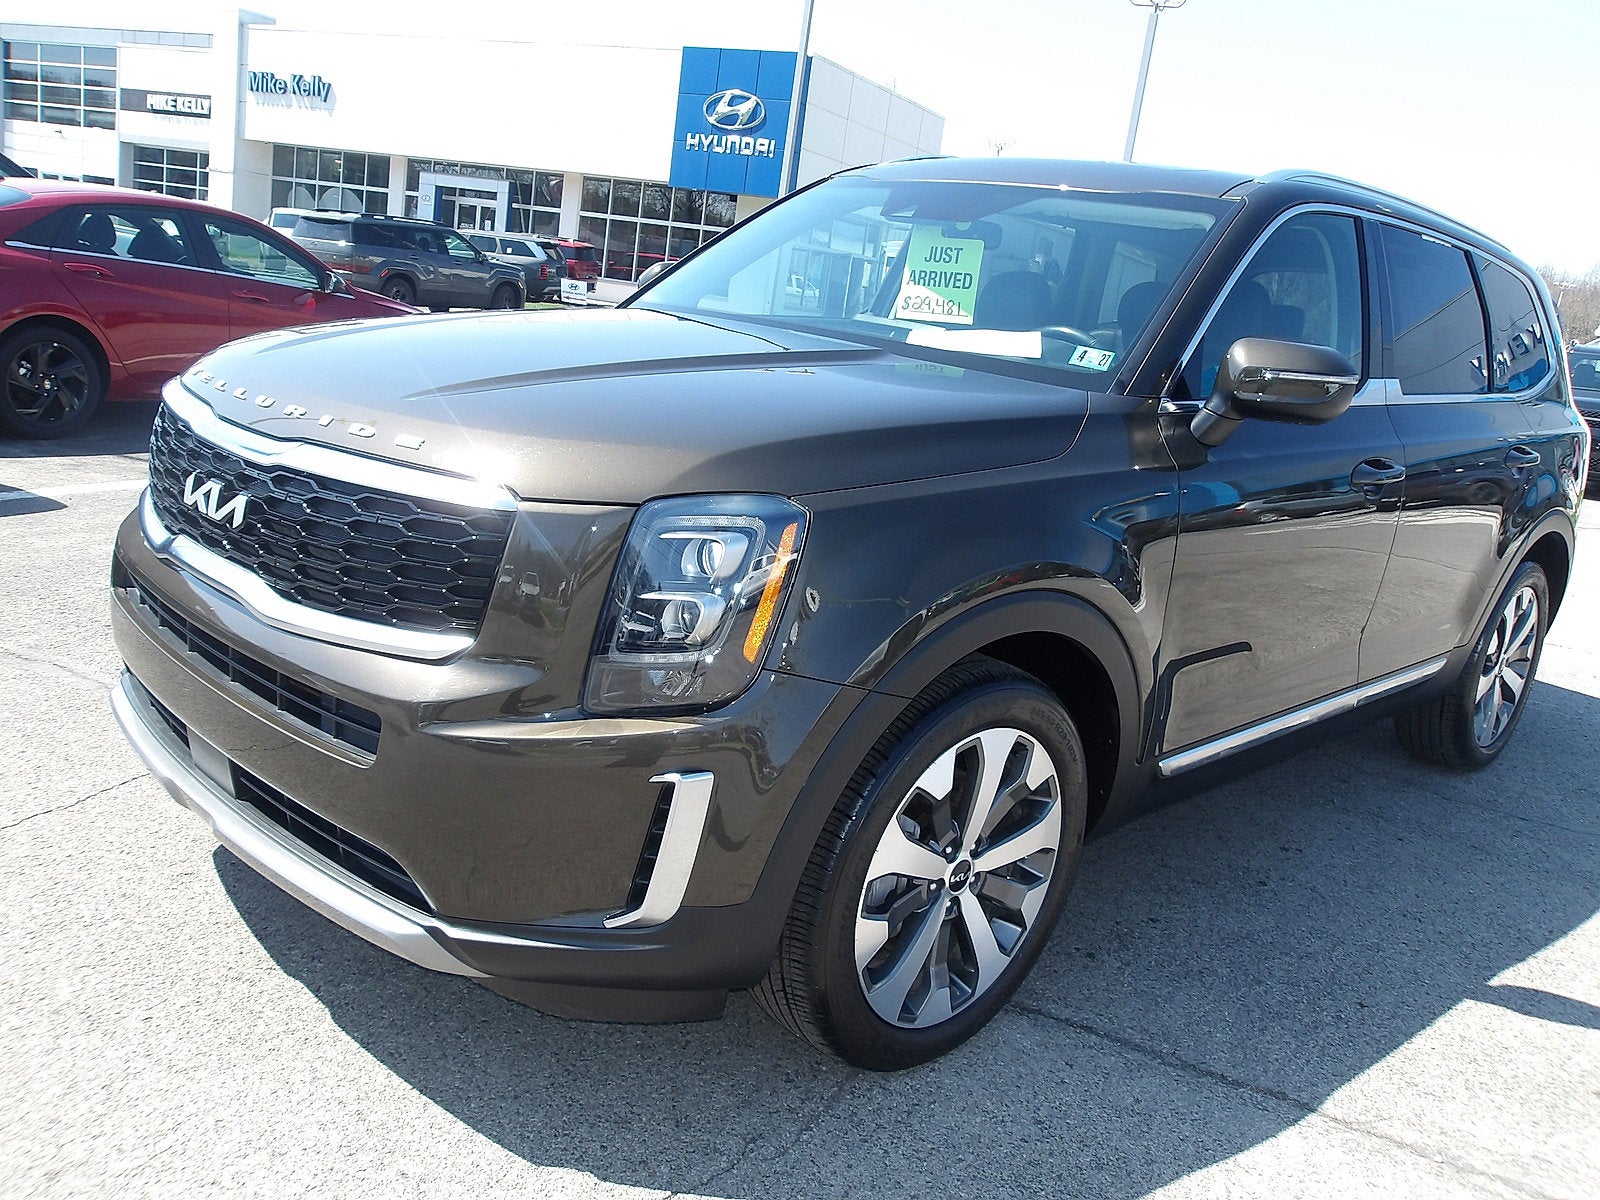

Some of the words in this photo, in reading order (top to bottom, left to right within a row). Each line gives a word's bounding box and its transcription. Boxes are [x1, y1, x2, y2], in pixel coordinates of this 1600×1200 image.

[249, 71, 287, 94] Mike
[290, 73, 331, 102] Kelly
[147, 93, 177, 113] MIKE
[176, 96, 211, 115] KELLY
[685, 132, 776, 158] HYUNDAI
[924, 246, 964, 264] JUST
[906, 269, 973, 290] ARRIVED
[901, 295, 961, 316] $29,481
[1097, 353, 1112, 366] 27
[193, 368, 425, 450] TELLURIDE
[183, 470, 250, 530] KIA
